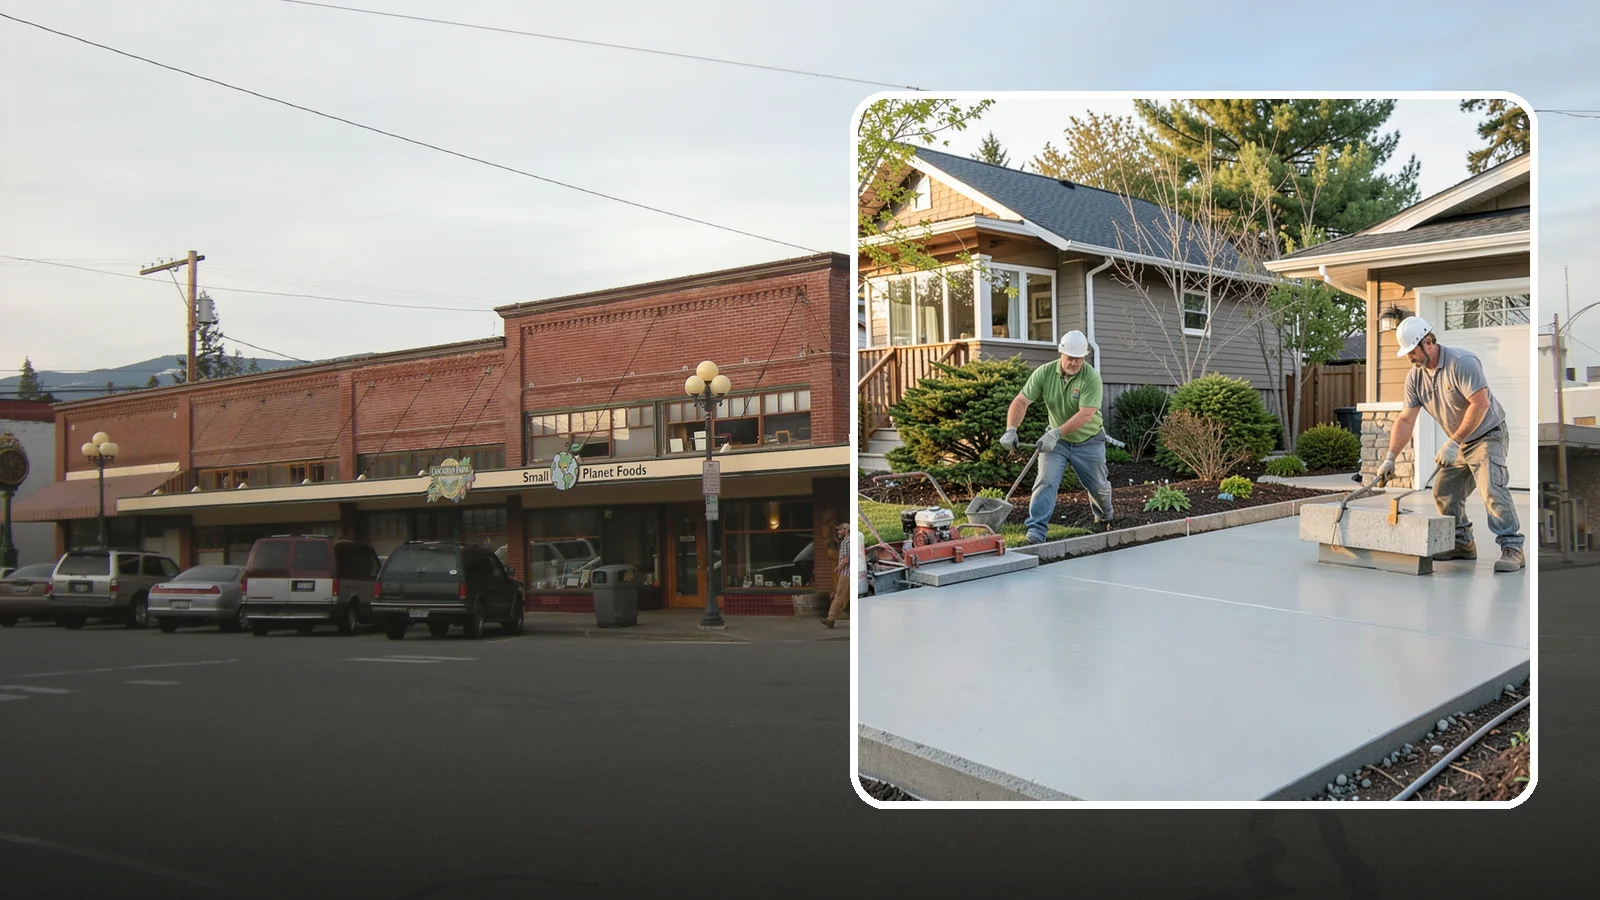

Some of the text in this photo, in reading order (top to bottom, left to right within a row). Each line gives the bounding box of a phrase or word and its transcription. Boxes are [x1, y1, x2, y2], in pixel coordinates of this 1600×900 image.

[523, 465, 647, 483] Small Planet Foods
